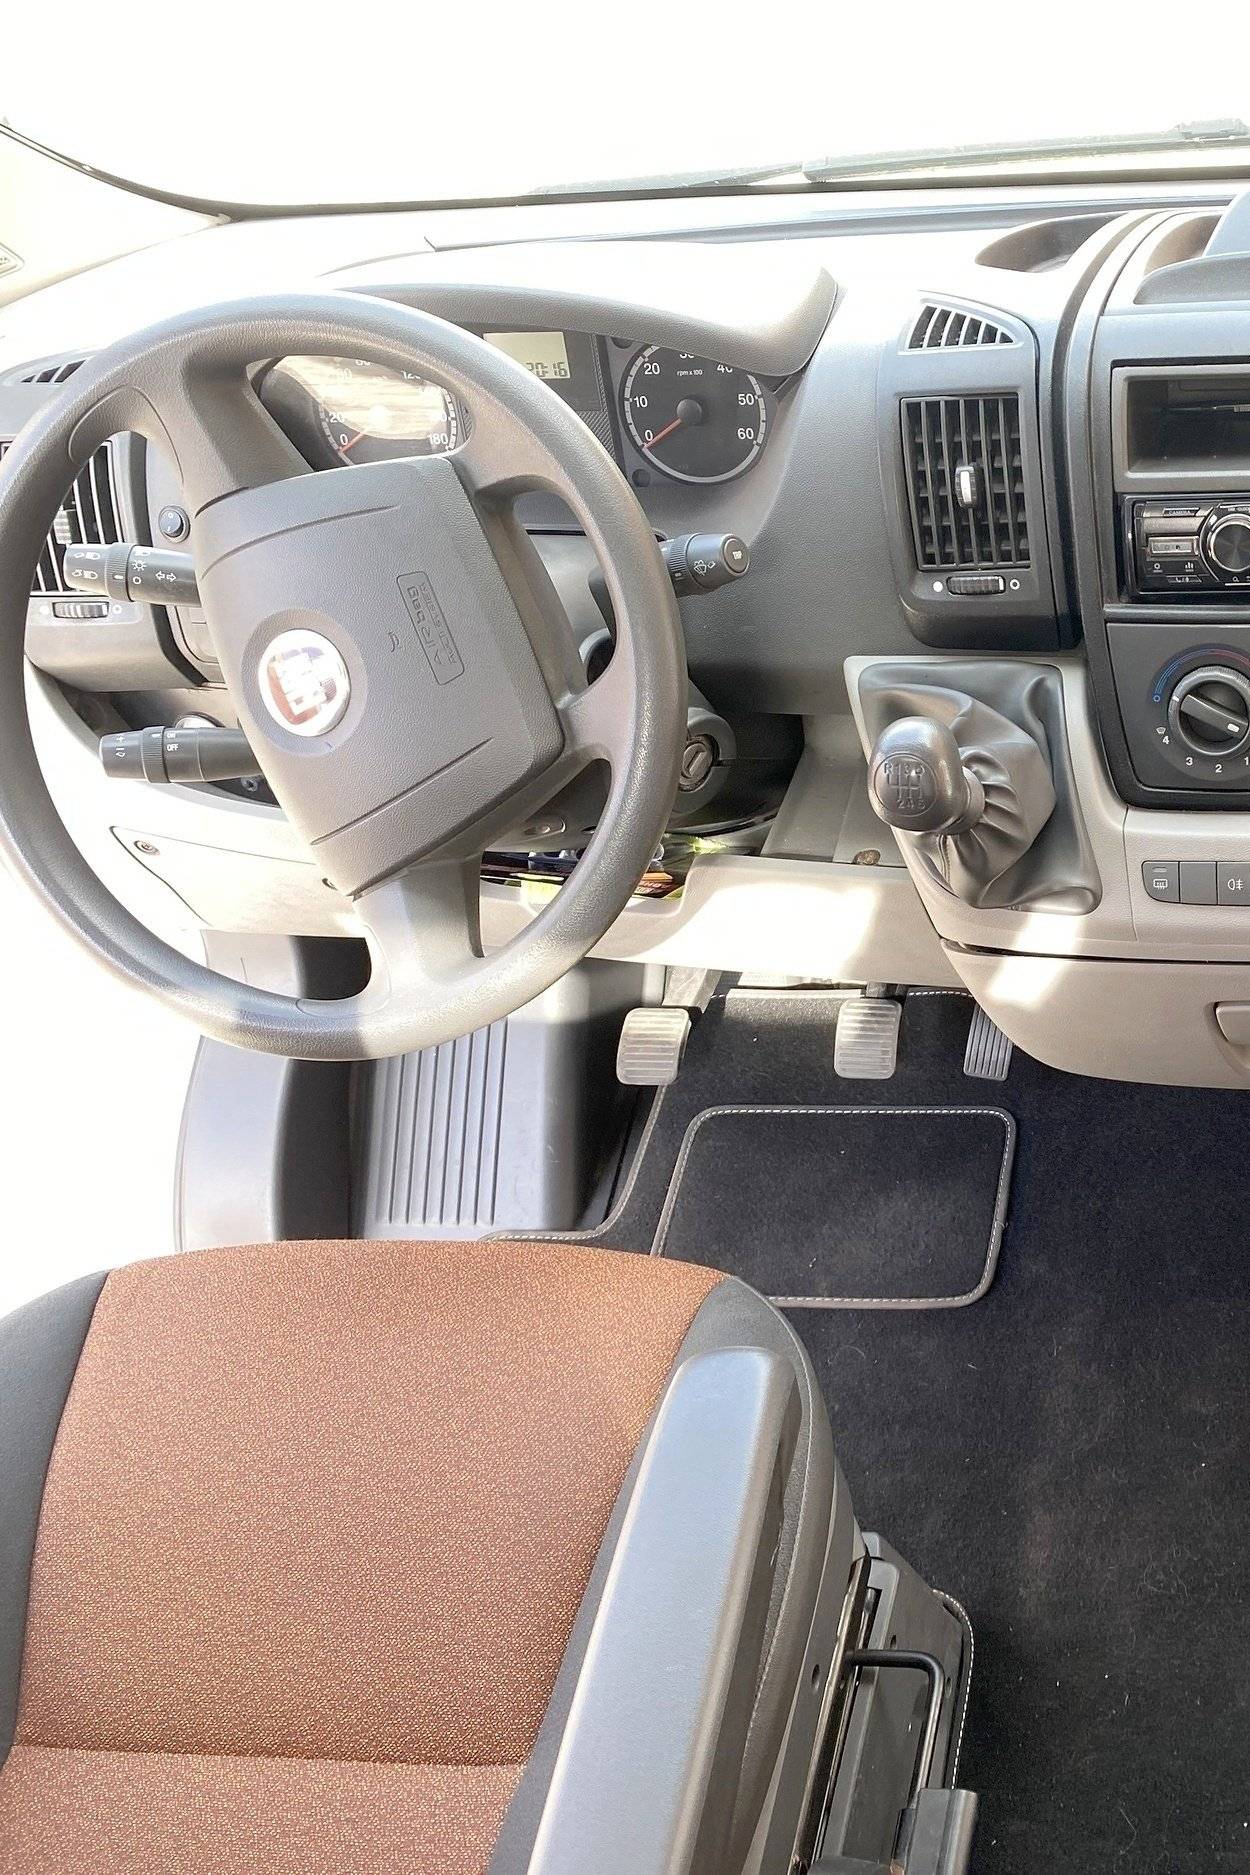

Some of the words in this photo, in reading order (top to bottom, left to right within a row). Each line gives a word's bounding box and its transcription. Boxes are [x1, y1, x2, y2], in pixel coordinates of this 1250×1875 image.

[644, 363, 660, 375] 20
[634, 396, 648, 408] 10
[738, 394, 755, 406] 50
[429, 433, 449, 445] 180
[645, 430, 653, 441] 0
[737, 428, 754, 440] 60
[339, 434, 348, 446] 0
[1162, 735, 1170, 745] 4
[166, 743, 179, 752] OFF
[1186, 756, 1194, 766] 3
[1244, 756, 1250, 766] 1
[884, 762, 893, 774] R
[1215, 763, 1223, 773] 2
[897, 800, 905, 809] 2
